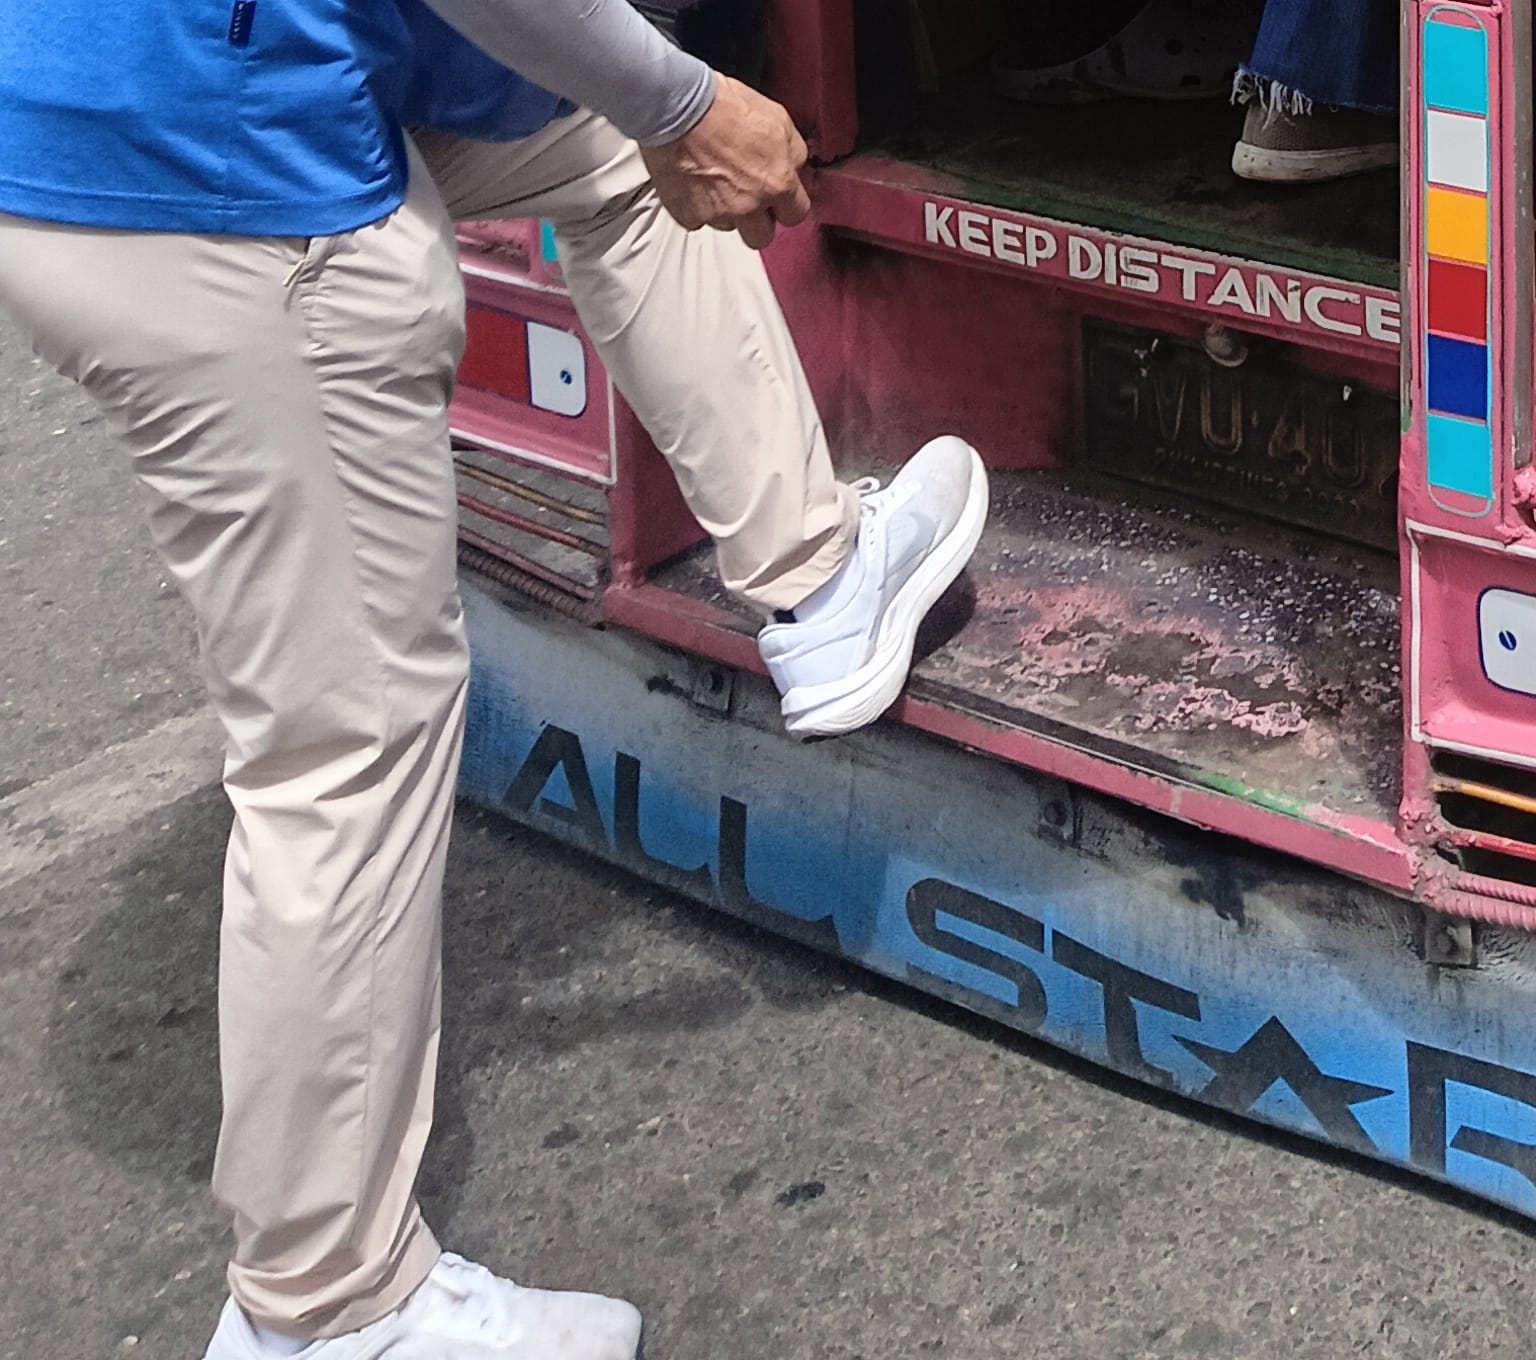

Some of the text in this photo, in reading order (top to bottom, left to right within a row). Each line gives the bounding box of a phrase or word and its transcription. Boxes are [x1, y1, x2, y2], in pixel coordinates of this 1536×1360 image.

[924, 201, 1401, 344] KEEP DISTANCE
[501, 723, 842, 961] ALL
